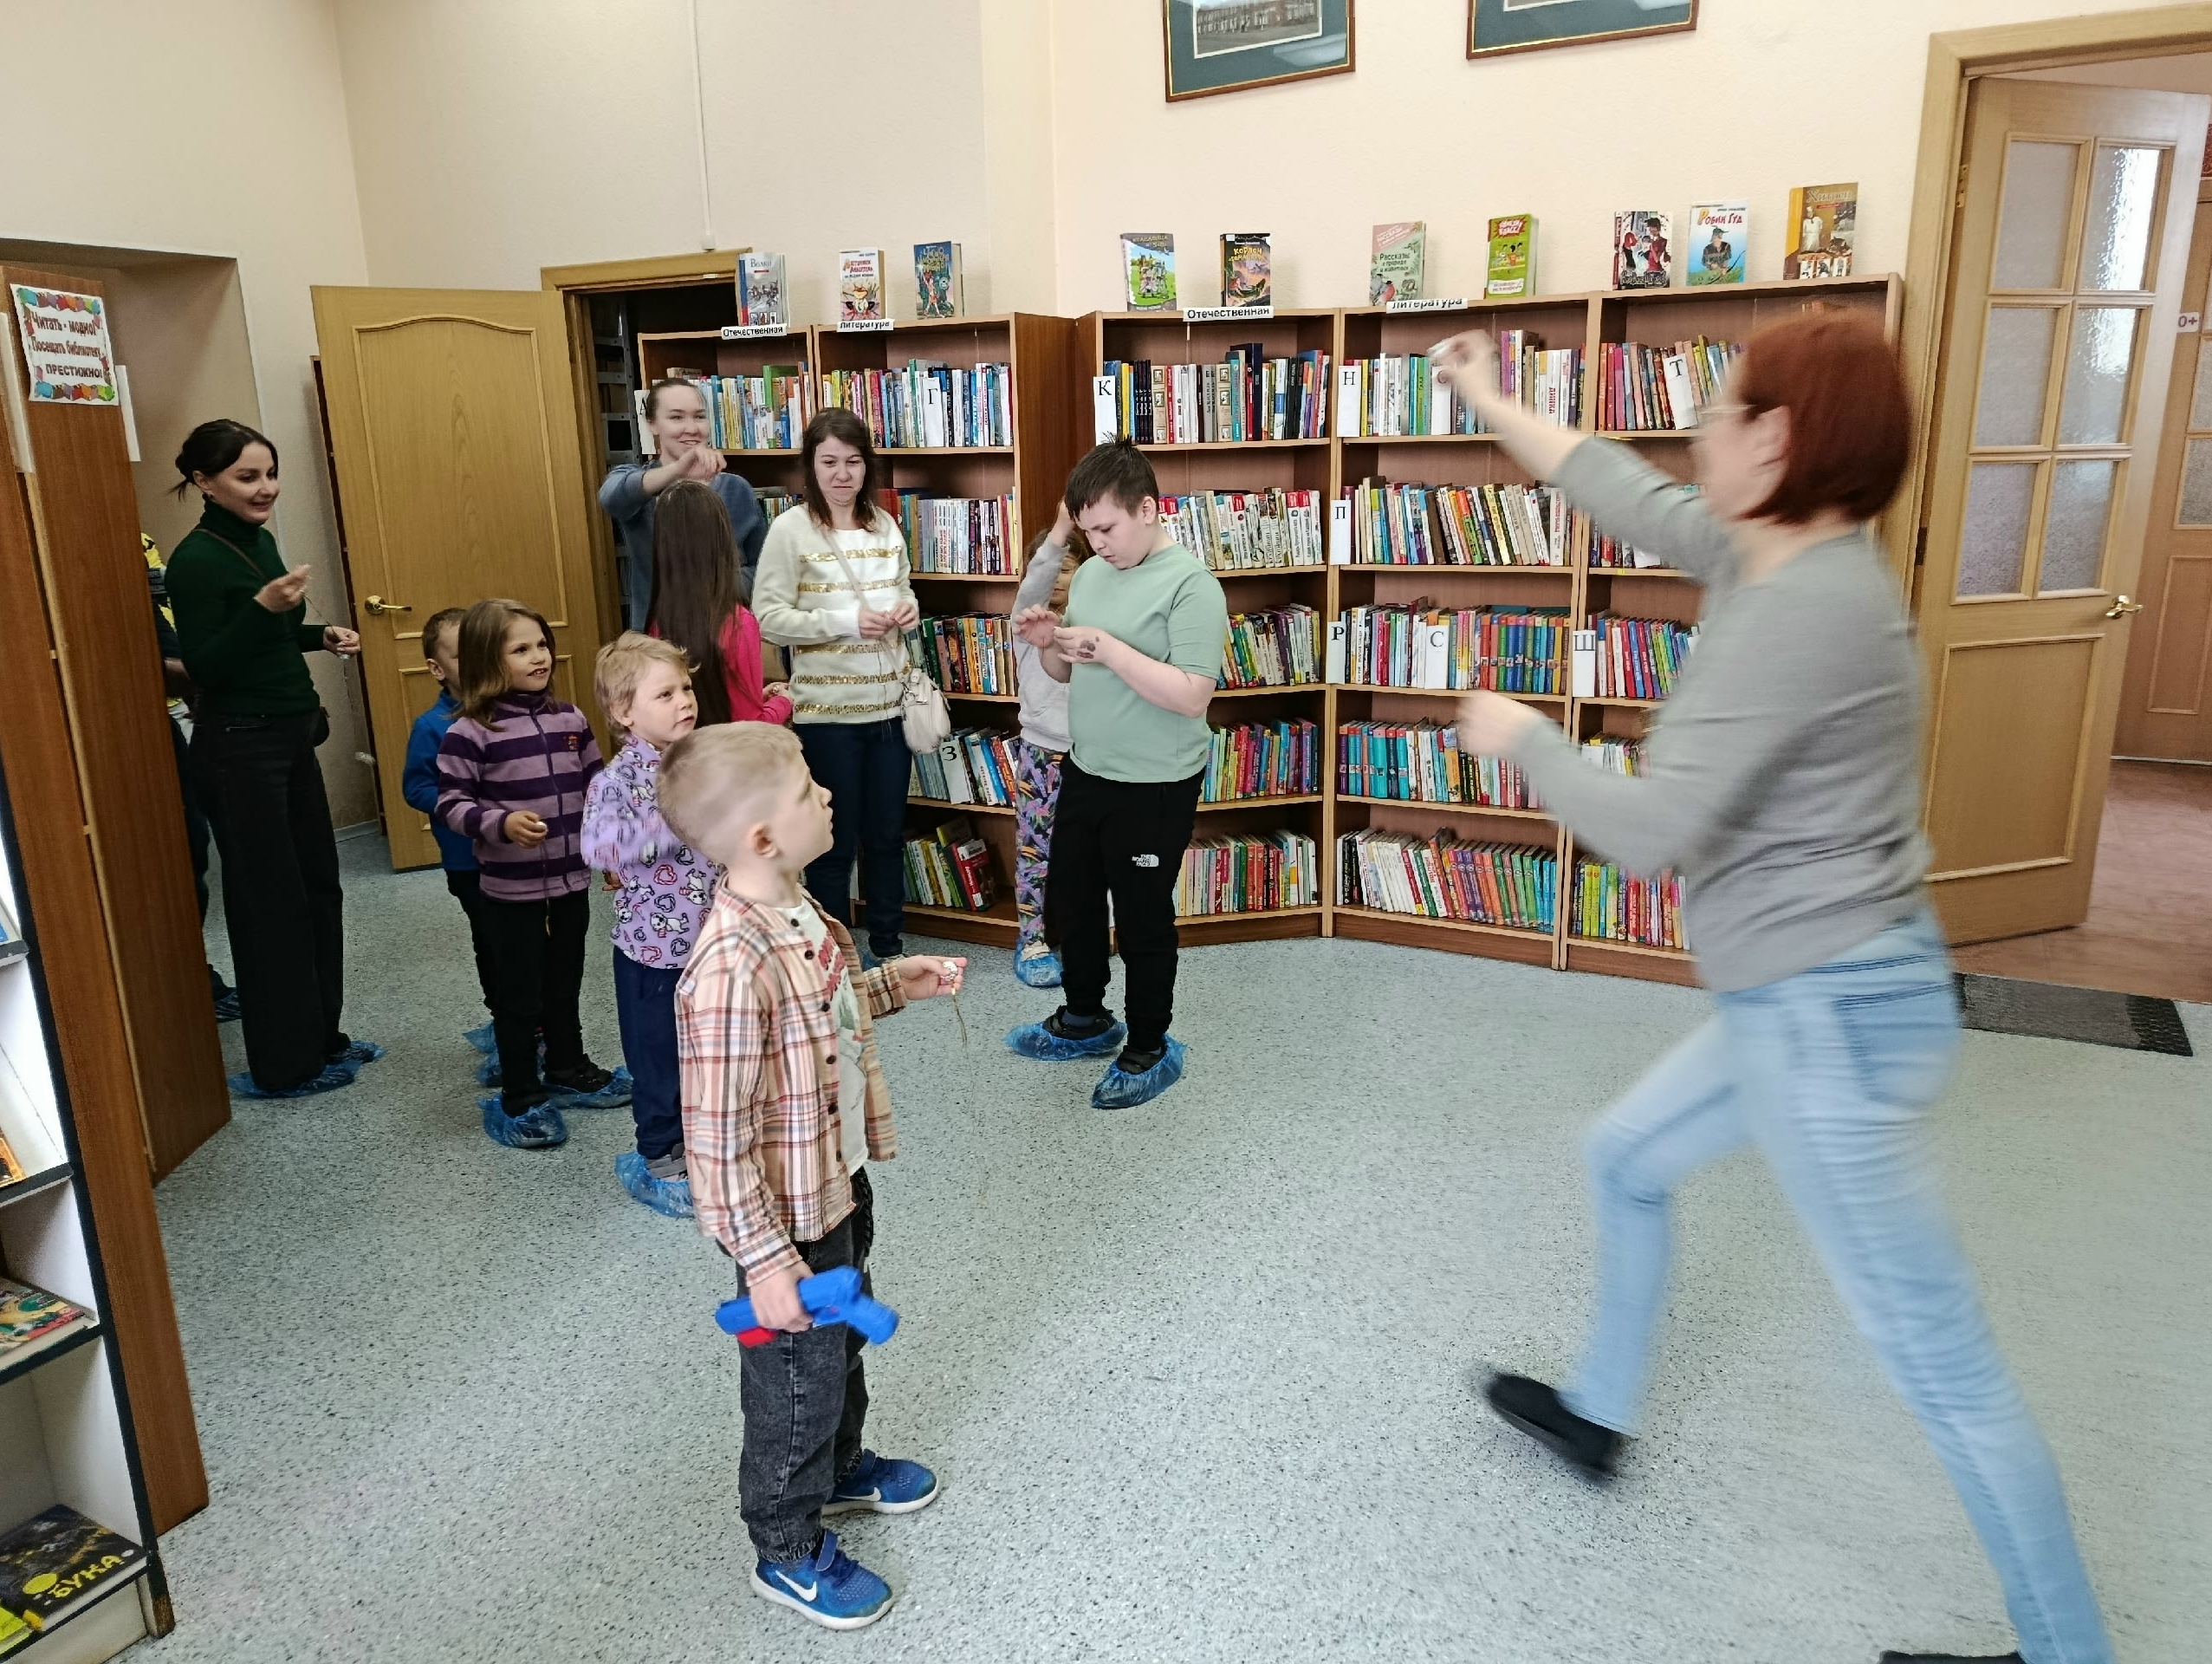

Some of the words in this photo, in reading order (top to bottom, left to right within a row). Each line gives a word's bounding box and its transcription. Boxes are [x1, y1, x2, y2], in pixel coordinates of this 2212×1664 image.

[32, 311, 62, 331] Читать
[1187, 307, 1270, 320] Отечественная
[2177, 315, 2198, 328] 0+
[723, 326, 784, 338] Отечественная
[31, 336, 66, 354] Посещать
[1669, 359, 1683, 378] Т
[1343, 371, 1356, 386] Н
[928, 387, 938, 405] Г
[1098, 380, 1112, 396] К
[1334, 506, 1346, 520] П
[1331, 626, 1345, 640] Р
[1430, 630, 1444, 647] С
[1573, 634, 1595, 652] Ш
